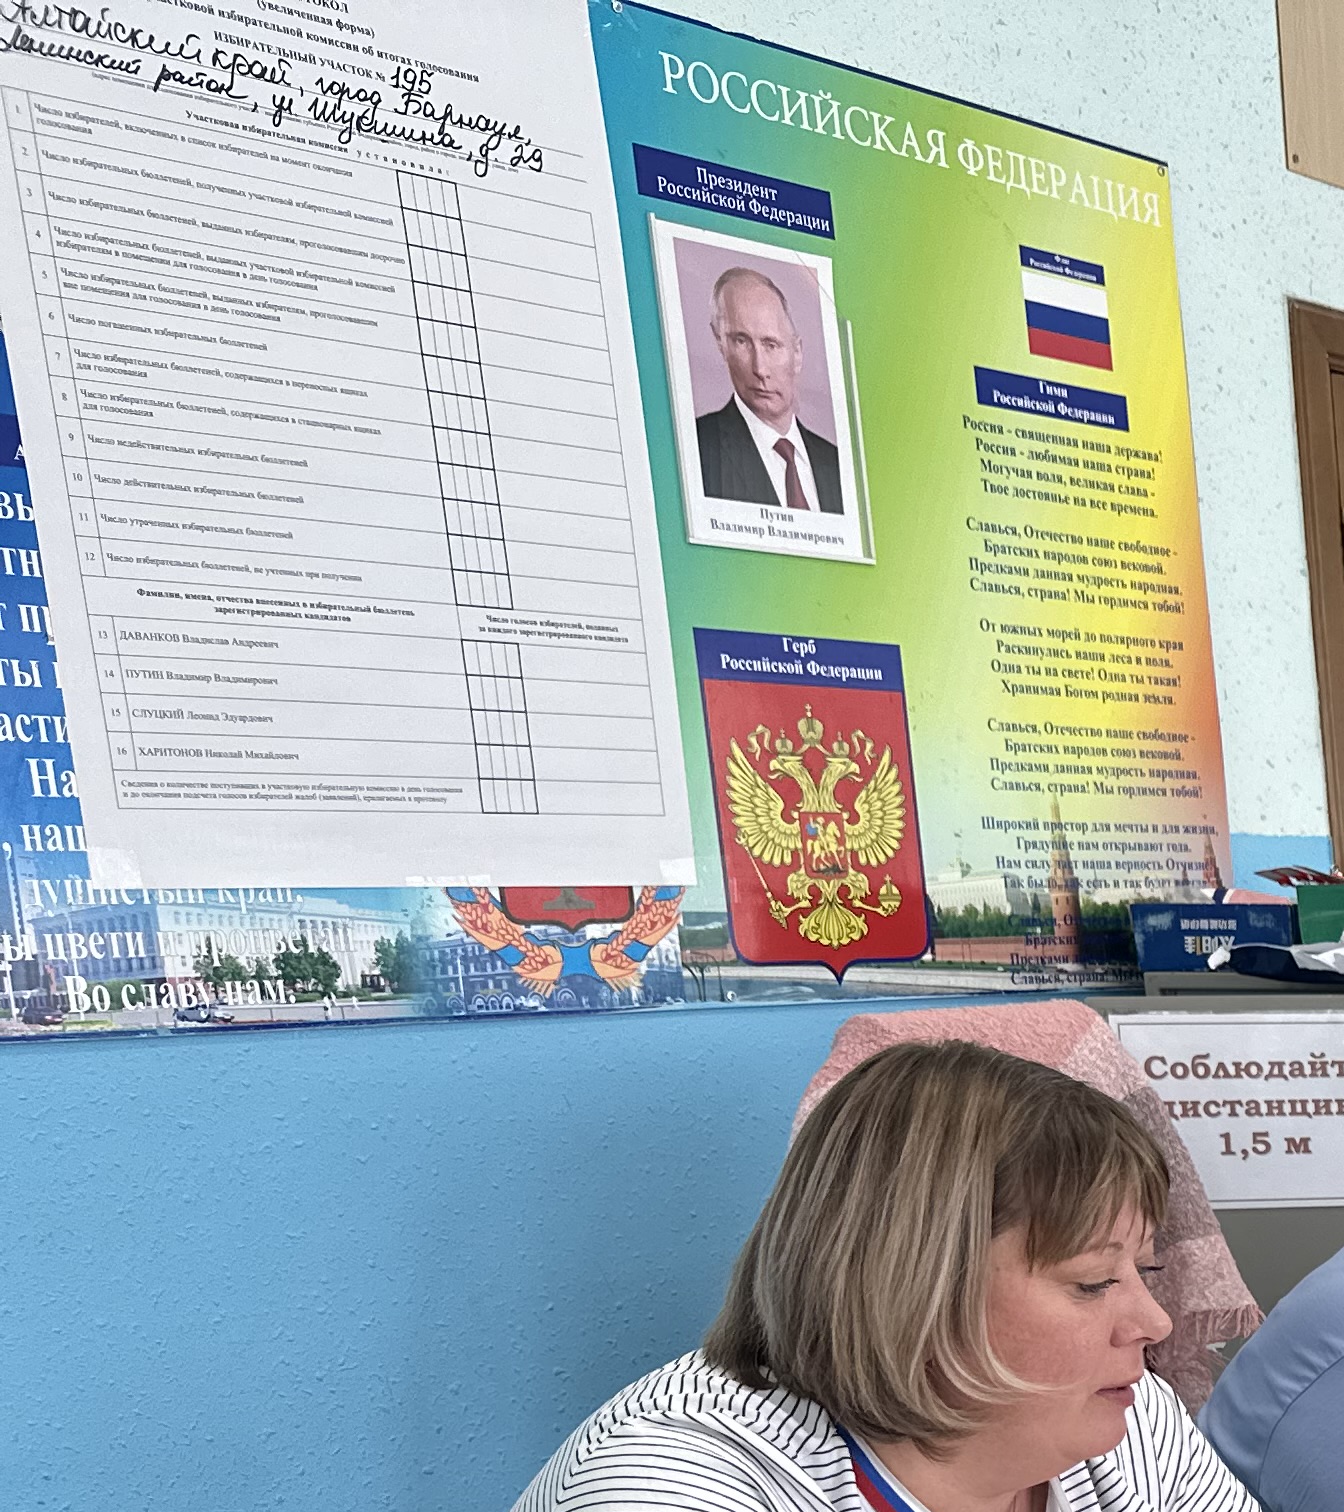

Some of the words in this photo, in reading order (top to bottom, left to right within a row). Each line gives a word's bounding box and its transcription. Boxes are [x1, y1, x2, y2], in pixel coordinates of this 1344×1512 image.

[336, 18, 375, 38] форма)
[214, 30, 317, 65] ИЗБИРАТЕЛЬНЫЙ
[320, 56, 373, 80] УЧАСТОК
[218, 8, 303, 38] избирательной
[307, 33, 359, 52] комиссии
[362, 46, 374, 56] об
[377, 50, 412, 66] итогах
[415, 60, 479, 83] голосования
[390, 66, 434, 95] 195
[186, 110, 239, 130] Участковая
[241, 124, 306, 147] избирательная
[659, 51, 950, 169] РОССИЙСКАЯ
[958, 138, 1162, 228] ФЕДЕРАЦИЯ
[696, 167, 778, 201] Президент
[657, 176, 746, 212] Российской
[749, 199, 830, 232] Федерации
[1038, 380, 1068, 399] Гимн
[993, 389, 1055, 414] Российской
[1057, 402, 1115, 425] Федерации
[962, 415, 1004, 435] Россия
[1015, 426, 1079, 448] священная
[1082, 440, 1111, 454] наша
[1115, 444, 1163, 464] держава!
[975, 437, 1017, 458] Россия
[1027, 449, 1080, 468] любимая
[1082, 460, 1112, 474] наша
[1115, 462, 1156, 482] страна!
[980, 458, 1032, 481] Могучая
[1069, 475, 1115, 493] великая
[1117, 484, 1149, 499] слава
[760, 507, 794, 524] Путин
[1073, 496, 1087, 507] на
[1090, 500, 1108, 511] все
[1110, 502, 1158, 519] времена.
[710, 518, 765, 538] Владимир
[767, 525, 845, 546] Владимирович
[966, 516, 1022, 538] Славься,
[1023, 524, 1084, 546] Отечество
[1086, 537, 1116, 550] наше
[1118, 541, 1171, 557] свободное
[983, 539, 1040, 560] Братских
[1043, 550, 1090, 567] народов
[968, 557, 1030, 578] Предками
[1032, 566, 1074, 582] данная
[1076, 572, 1128, 590] мудрость
[969, 577, 1025, 599] Славься,
[1027, 587, 1071, 603] страна!
[1073, 590, 1096, 604] Мы
[1098, 595, 1149, 611] гордимся
[98, 630, 108, 640] 13
[119, 630, 180, 644] ДАВАНКОВ
[782, 637, 817, 658] Герб
[104, 669, 114, 679] 14
[125, 669, 164, 681] ПУТИН
[166, 671, 212, 685] Владимир
[214, 673, 278, 686] Владимирович
[720, 653, 804, 675] Российской
[807, 660, 883, 682] Федерации
[111, 708, 121, 718] 15
[131, 707, 184, 722] СЛУЦКИЙ
[117, 747, 127, 757] 16
[138, 746, 203, 759] ХАРИТОНОВ
[205, 748, 243, 760] Николай
[245, 750, 300, 762] Михайлович
[45, 931, 146, 961] цвети
[63, 975, 111, 1014] Во
[121, 981, 214, 1017] славу
[224, 979, 297, 1006] нам.
[1220, 1131, 1272, 1161] 1,5
[1284, 1136, 1312, 1155] м
